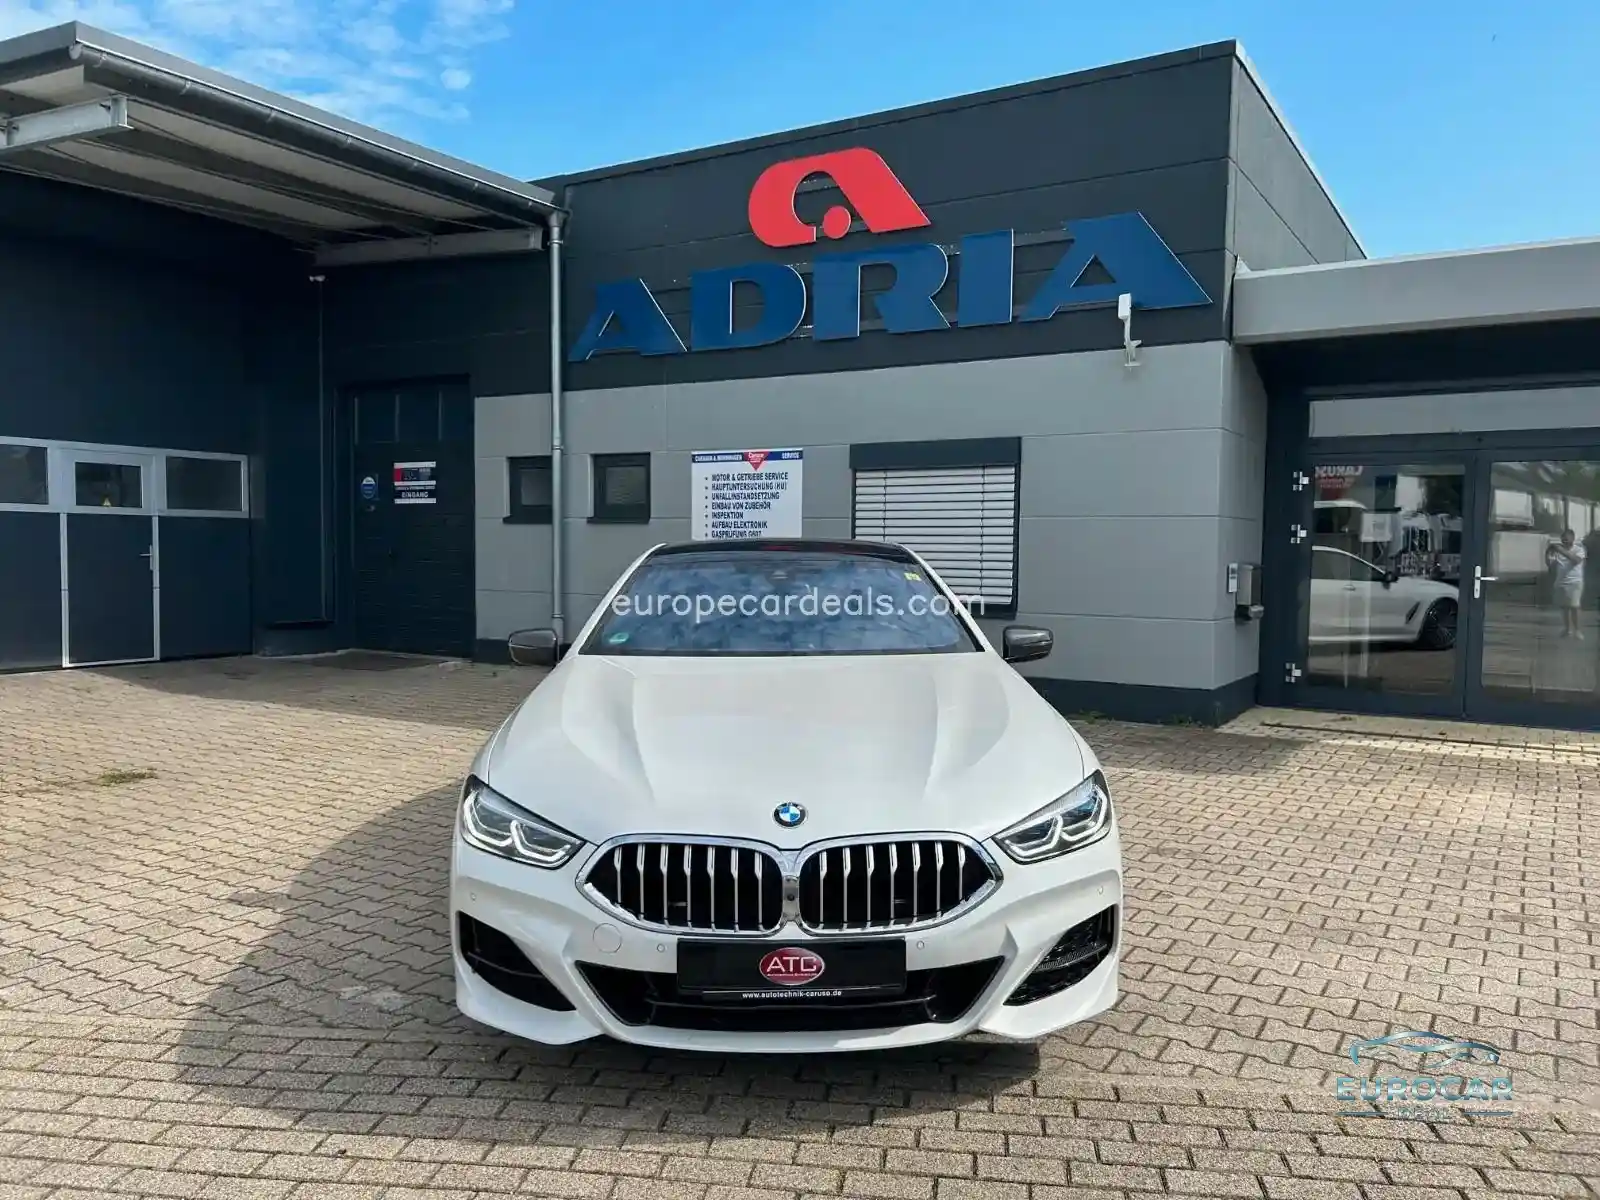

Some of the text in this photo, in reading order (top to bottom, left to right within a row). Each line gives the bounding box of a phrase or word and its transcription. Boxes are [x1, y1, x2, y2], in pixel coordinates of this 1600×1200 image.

[567, 210, 1214, 362] ADRIA
[711, 472, 789, 482] MOTOR & GETRIEBE SERVICE
[711, 482, 773, 491] HAUPTUNTERSUCHUNG
[711, 492, 780, 500] UNFALLINSTANDSETZUNG
[711, 502, 732, 510] EINBAU
[732, 502, 744, 510] VON
[711, 511, 744, 520] INSPEKTION
[711, 521, 768, 529] AUFBAU ELEKTRONIK
[766, 956, 817, 973] ATC
[742, 989, 842, 999] www.autotechnik-caruso.de
